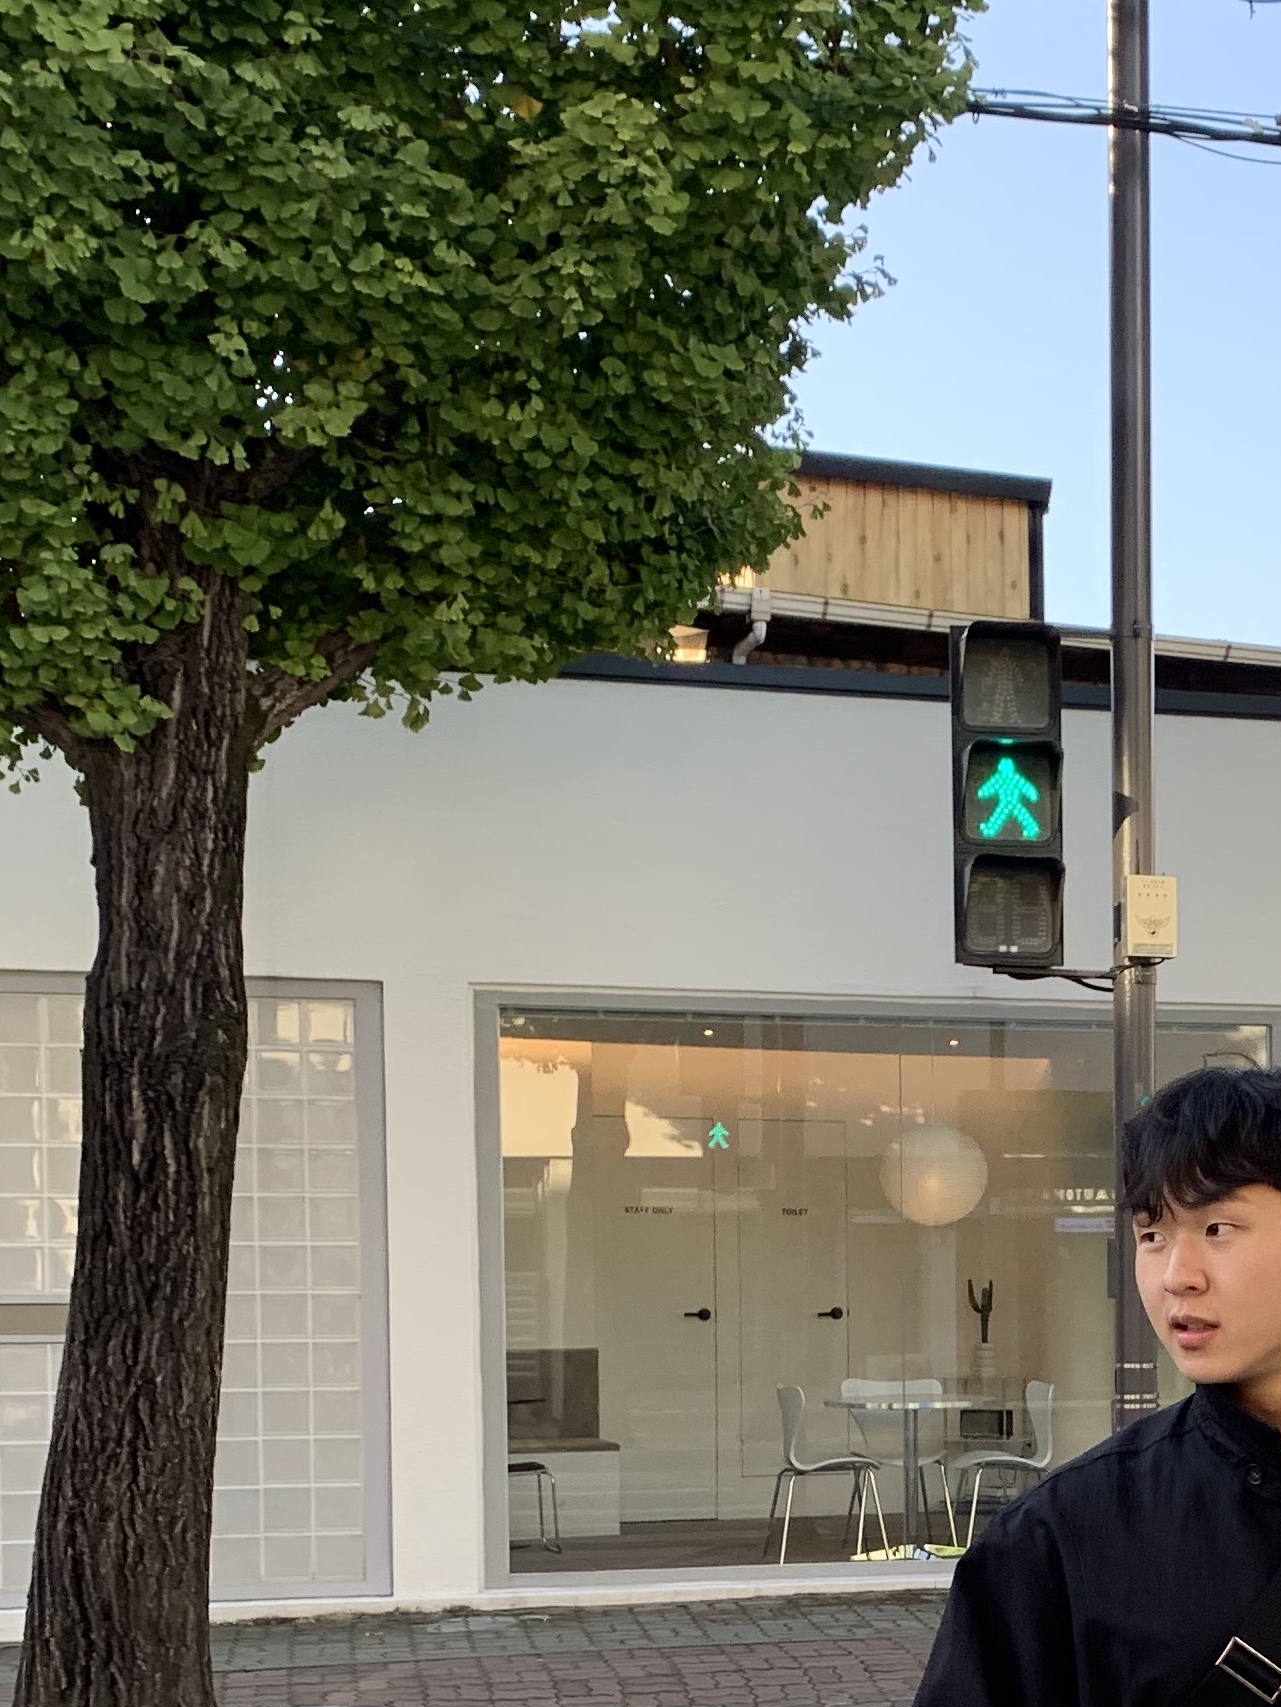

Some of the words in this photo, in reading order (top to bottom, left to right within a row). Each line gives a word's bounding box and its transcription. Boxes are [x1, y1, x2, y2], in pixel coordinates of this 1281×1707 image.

[624, 1206, 650, 1214] STAFF
[651, 1207, 674, 1215] ONLY
[781, 1207, 809, 1216] TOILET
